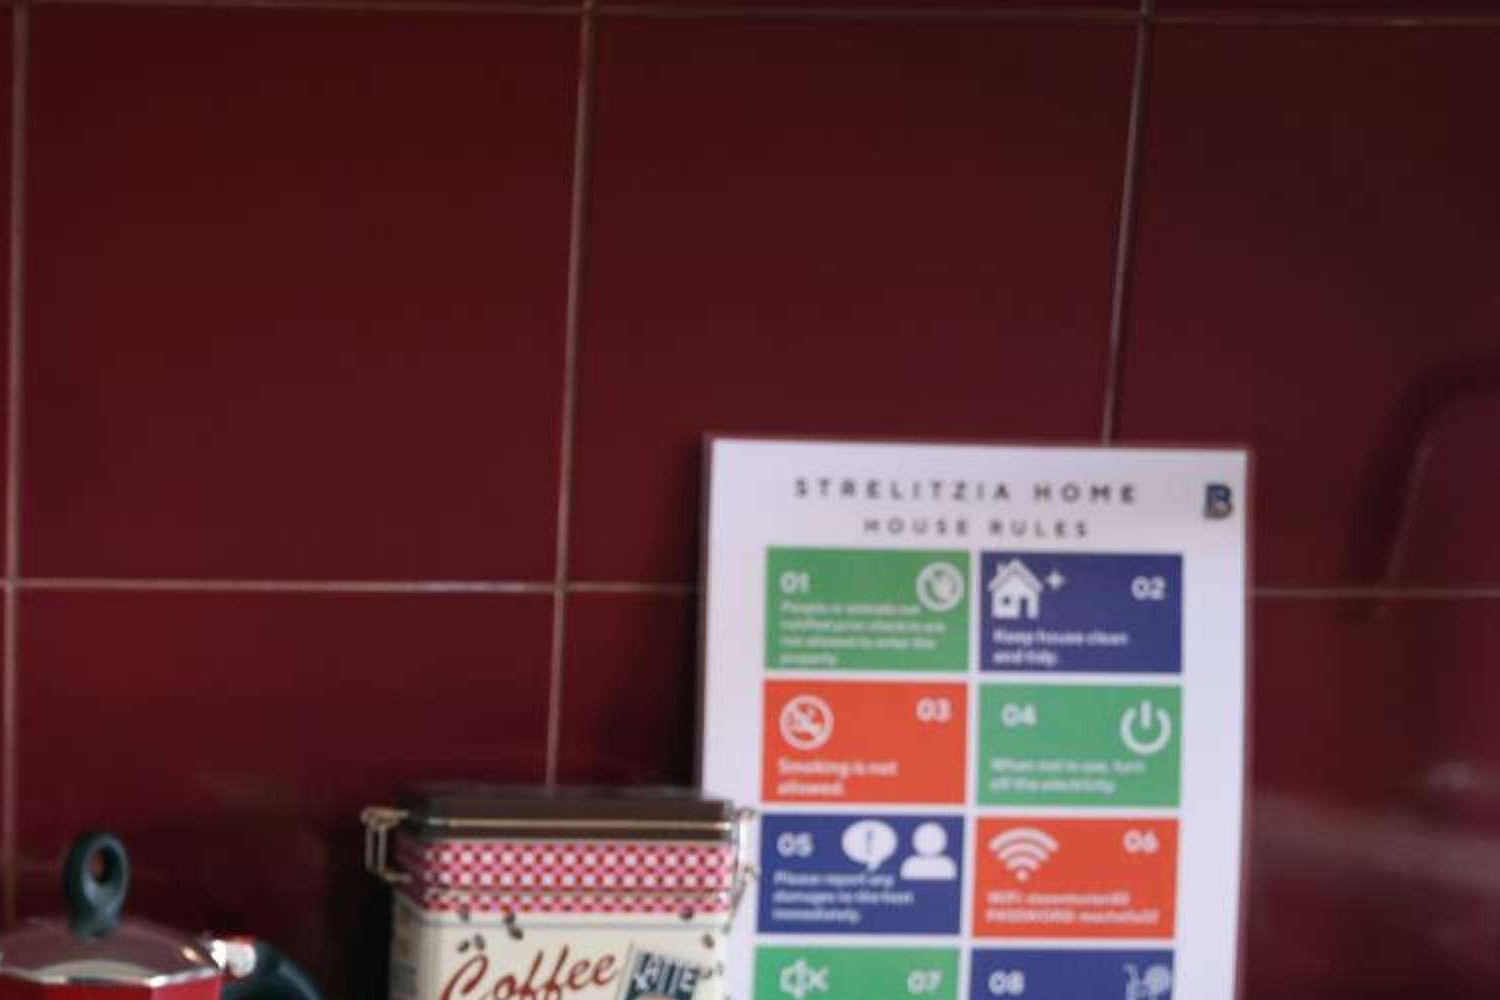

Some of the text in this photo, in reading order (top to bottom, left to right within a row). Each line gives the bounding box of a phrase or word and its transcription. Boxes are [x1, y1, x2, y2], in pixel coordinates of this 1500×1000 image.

[795, 479, 1136, 505] STRELITZIA HOME
[864, 518, 1088, 538] HOUSE RULES
[780, 571, 809, 594] 01
[1130, 574, 1167, 601] 02
[993, 628, 1129, 649] Keep house clean
[992, 648, 1024, 664] and
[916, 698, 951, 723] 03
[1002, 704, 1037, 727] 04
[777, 756, 899, 780] Smoking is not
[775, 832, 814, 858] 05
[1123, 829, 1159, 854] 06
[907, 969, 942, 994] 07
[988, 970, 1026, 996] 08
